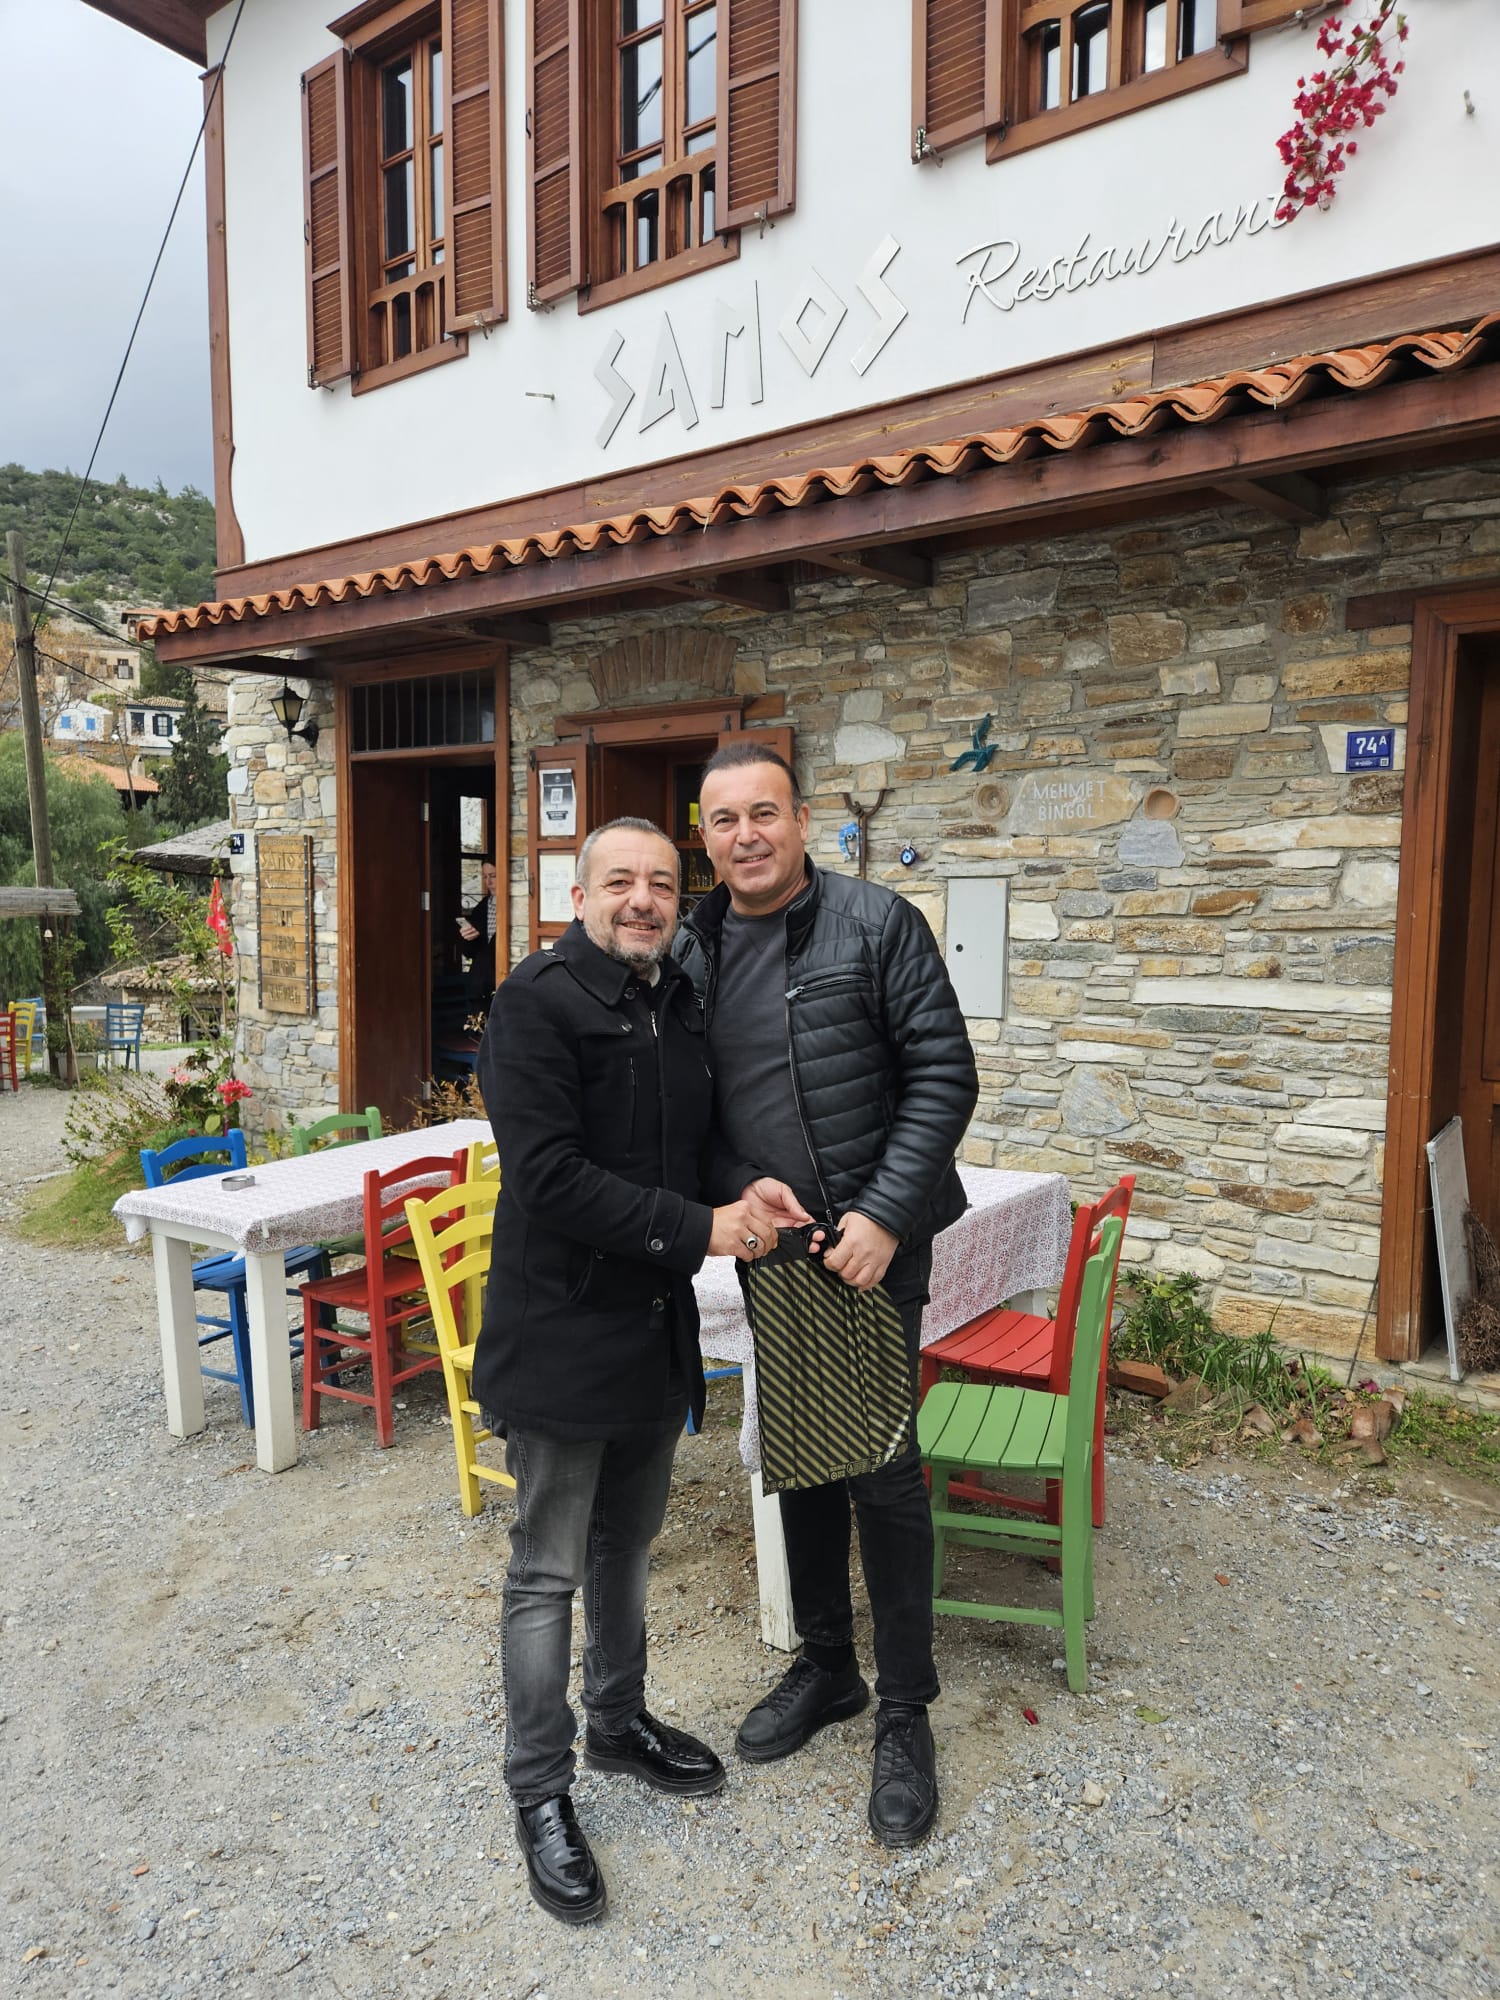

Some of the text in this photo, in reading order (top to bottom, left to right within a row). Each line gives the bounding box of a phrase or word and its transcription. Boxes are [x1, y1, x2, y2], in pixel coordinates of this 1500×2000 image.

[593, 192, 1305, 450] SAMOS Restaurant
[1033, 780, 1106, 800] MEHMET
